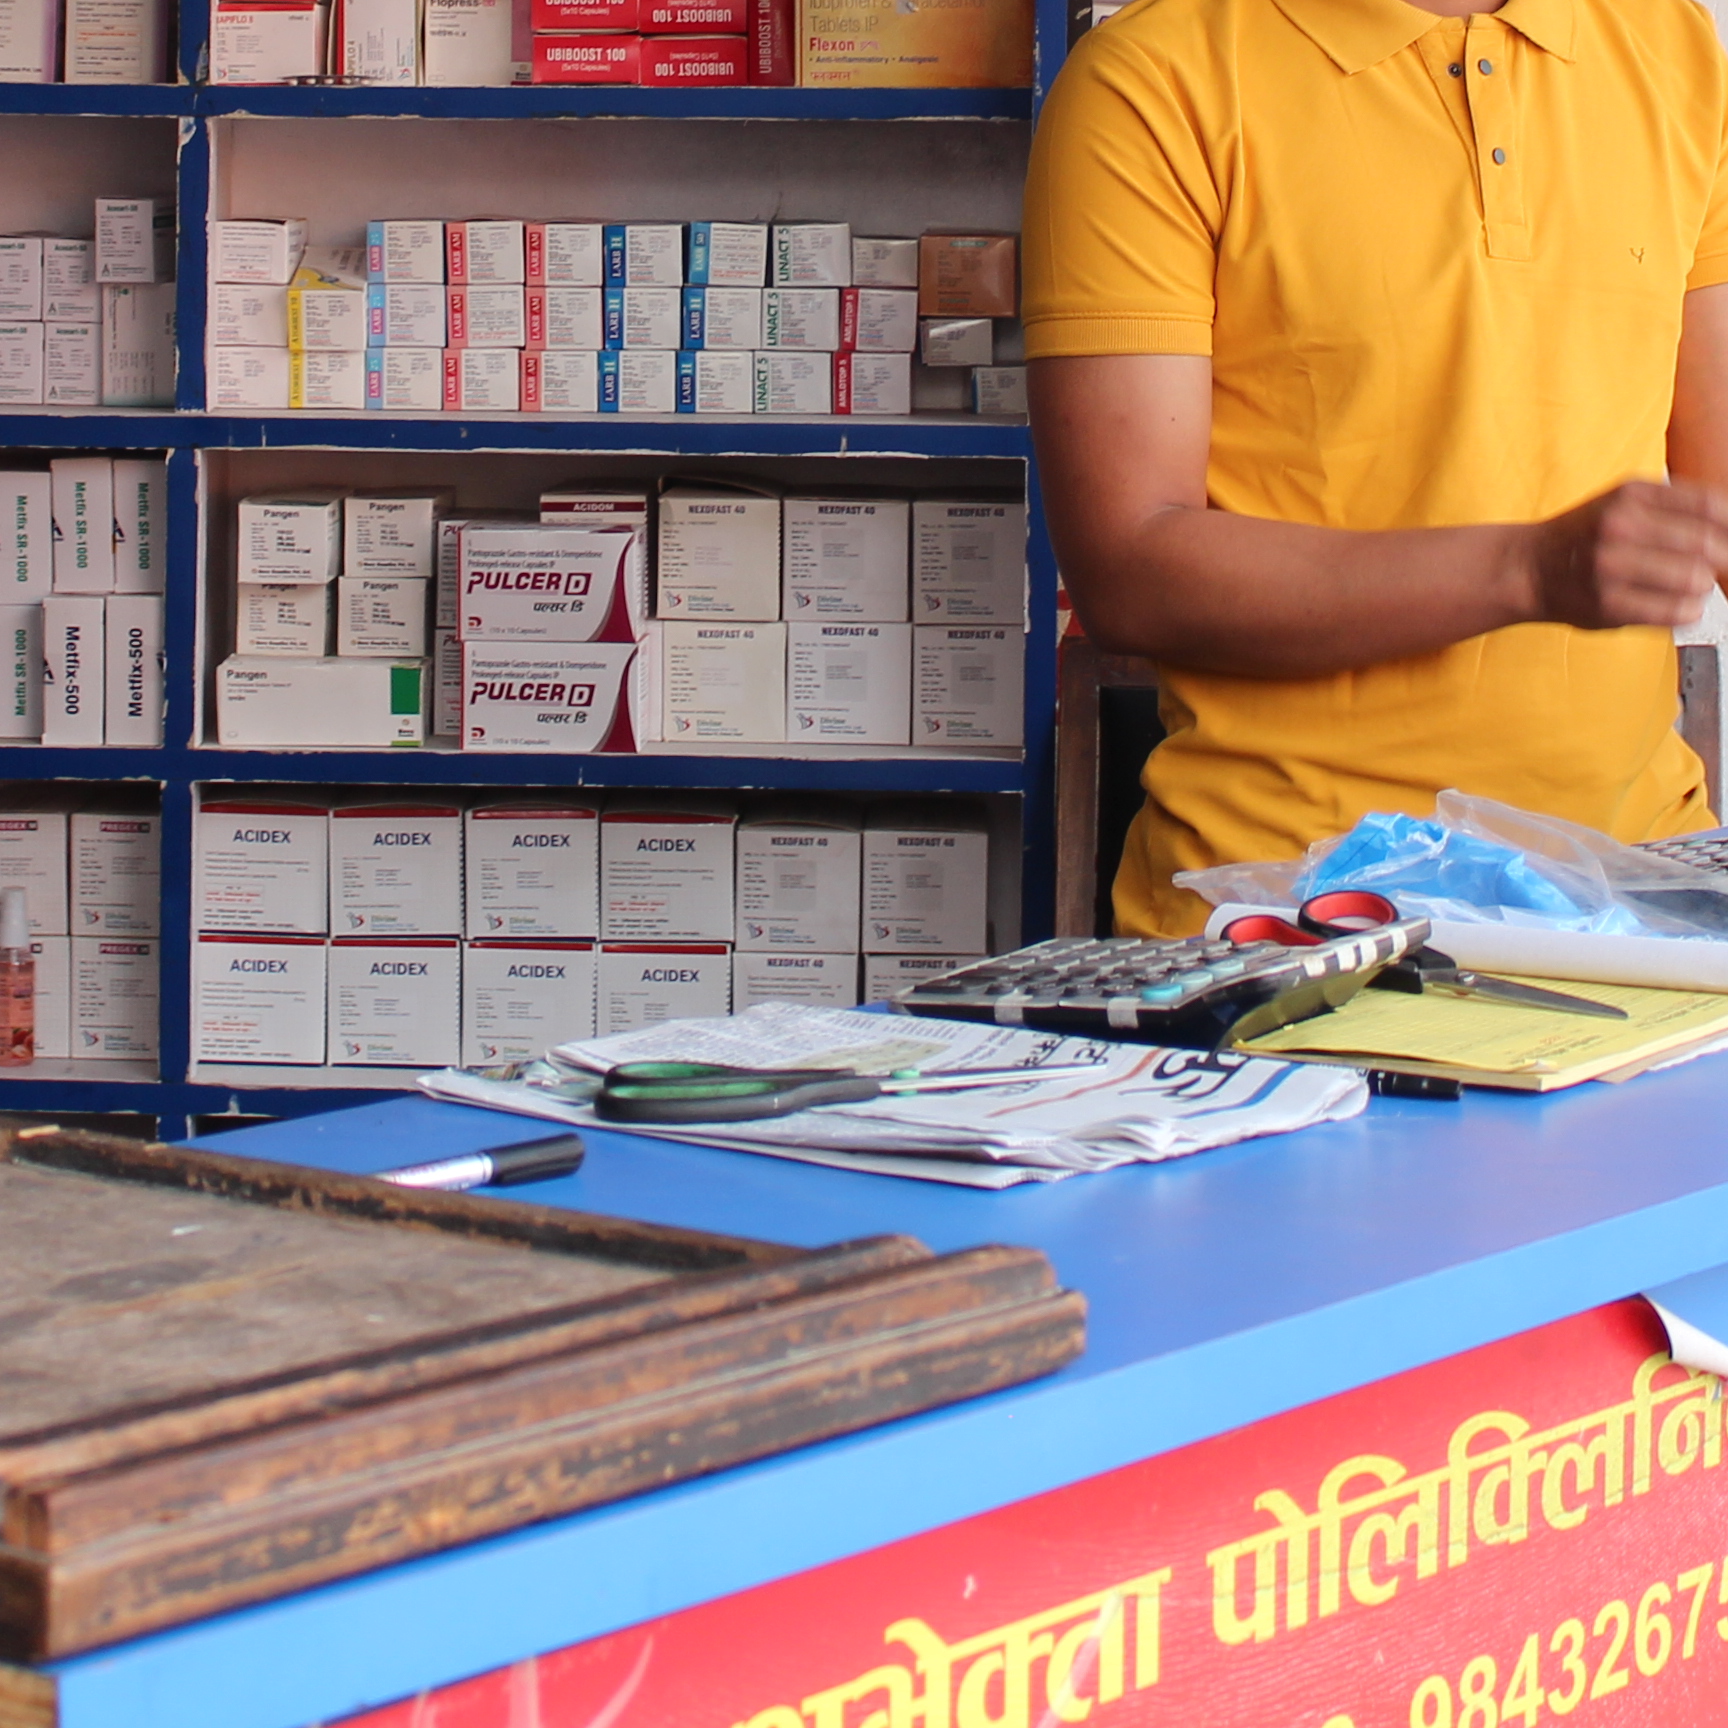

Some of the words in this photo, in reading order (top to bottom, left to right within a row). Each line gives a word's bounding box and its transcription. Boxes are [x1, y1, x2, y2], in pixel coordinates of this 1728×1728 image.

[759, 15, 772, 74] UBIBOOST
[452, 232, 464, 250] AM
[452, 251, 464, 276] LARB
[611, 249, 622, 278] LARB
[779, 239, 790, 282] LINACT
[369, 502, 405, 514] Pangen
[573, 502, 614, 512] ACIDOM
[466, 571, 562, 595] PULCER
[128, 627, 143, 718] Metfix-500
[225, 669, 268, 682] Pangen
[232, 829, 291, 845] ACIDEX
[370, 960, 429, 977] ACIDEX
